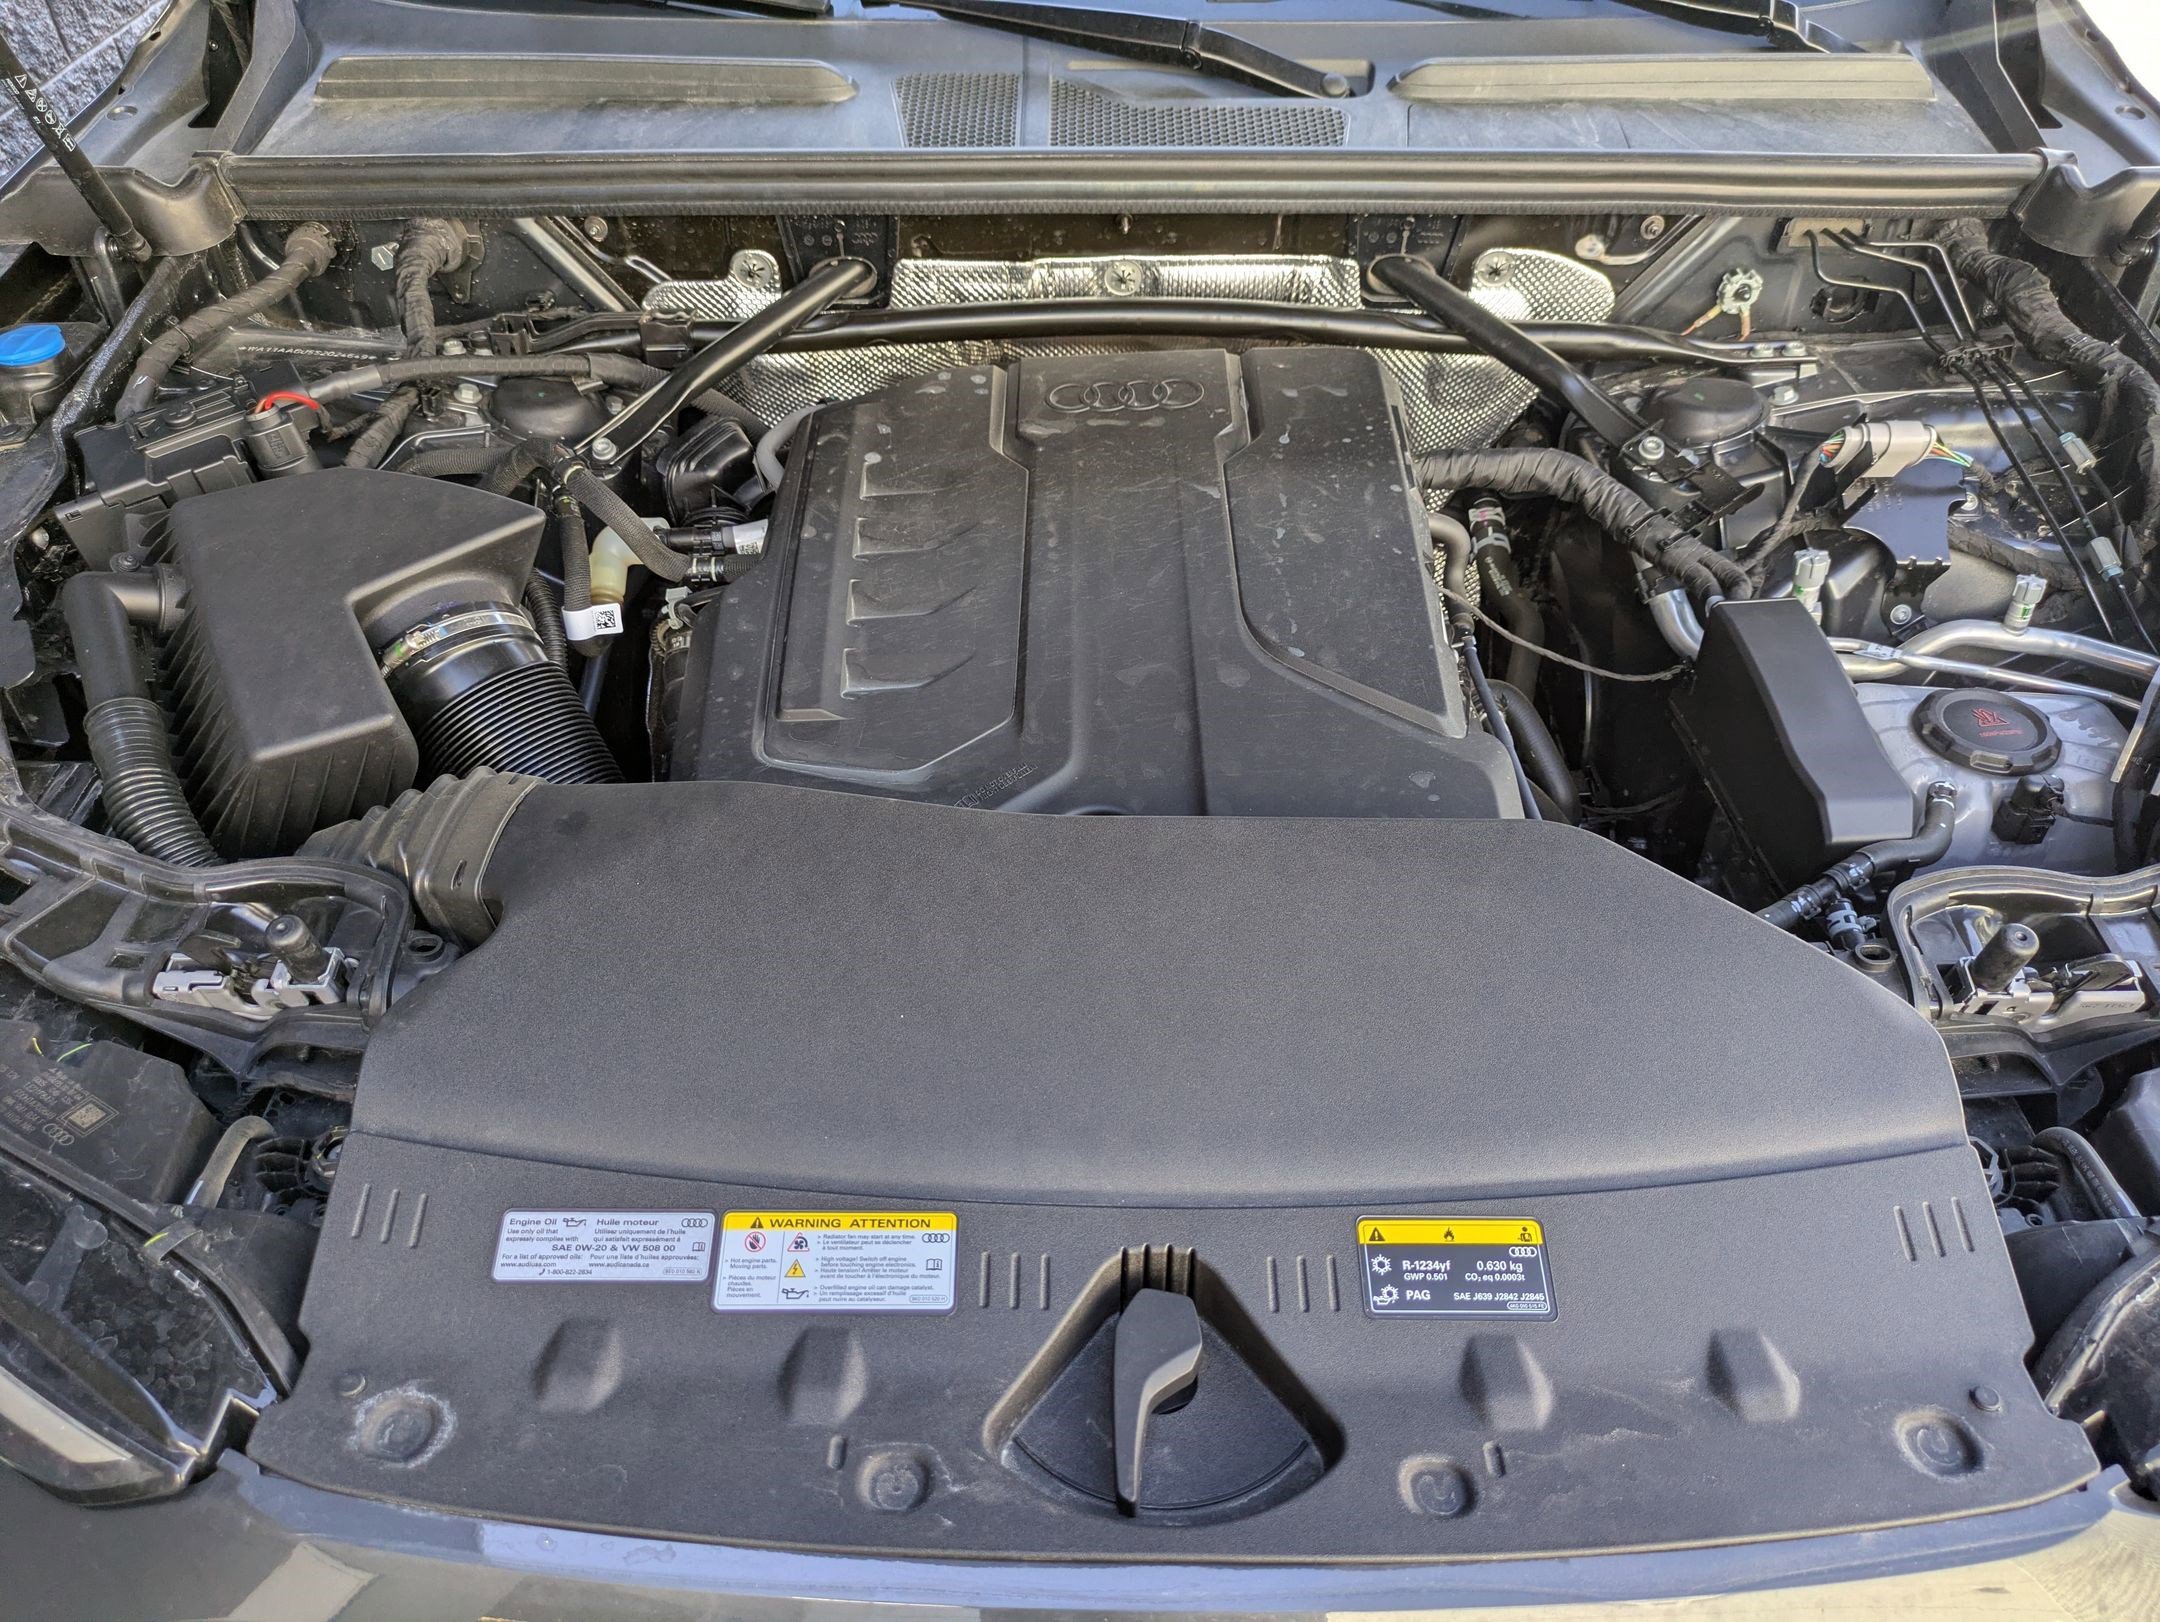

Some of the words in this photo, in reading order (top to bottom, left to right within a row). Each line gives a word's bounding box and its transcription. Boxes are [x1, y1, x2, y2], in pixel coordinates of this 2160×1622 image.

[510, 1218, 541, 1226] Engine
[770, 1219, 841, 1228] WARNING
[850, 1219, 931, 1228] ATTENTION
[1402, 1260, 1451, 1272] R-1234yf
[1476, 1261, 1506, 1270] 0.630
[1510, 1261, 1523, 1272] kg
[1406, 1290, 1431, 1300] PAG
[1454, 1292, 1471, 1300] SAE
